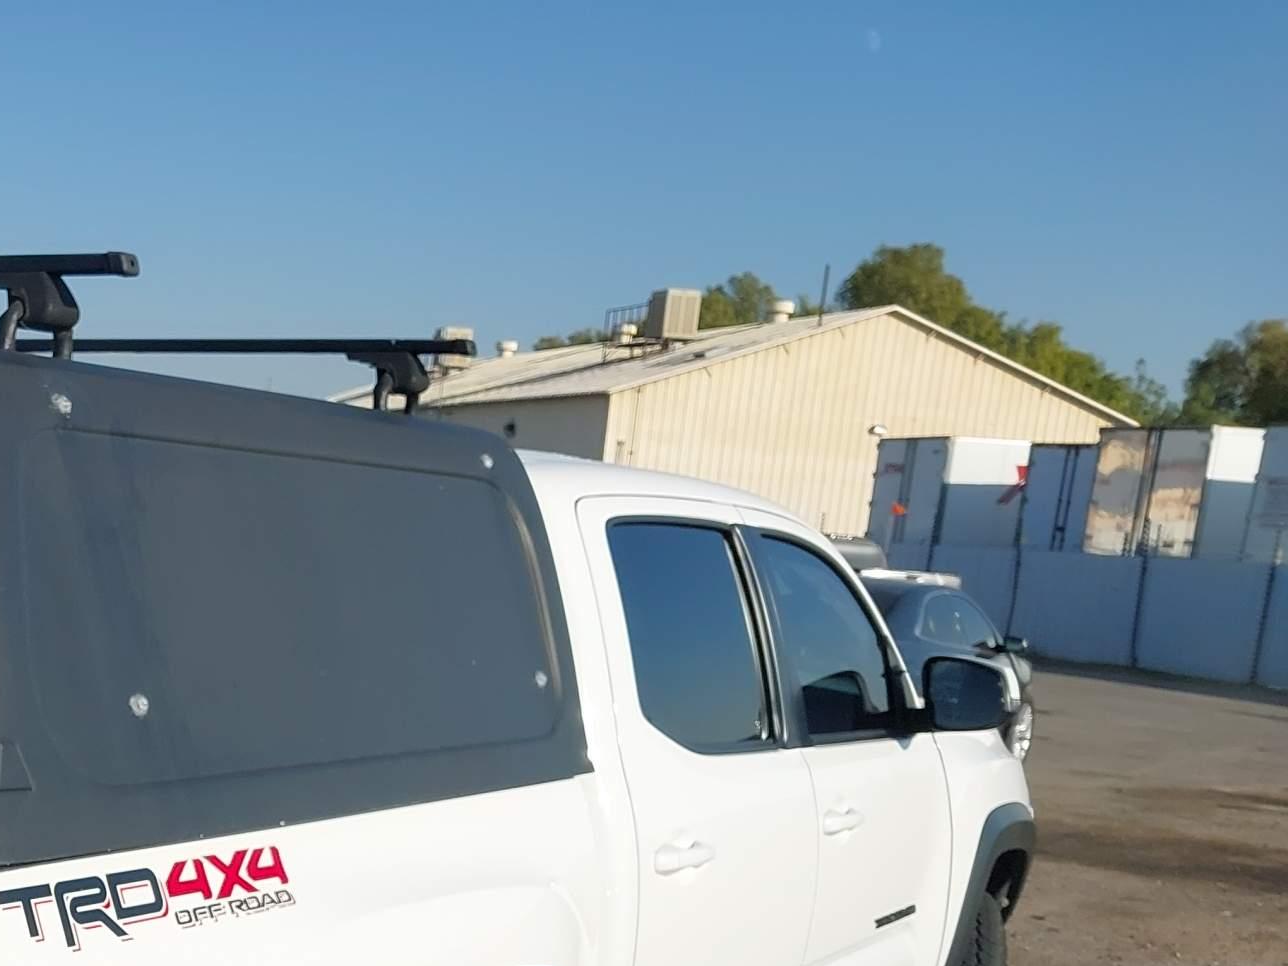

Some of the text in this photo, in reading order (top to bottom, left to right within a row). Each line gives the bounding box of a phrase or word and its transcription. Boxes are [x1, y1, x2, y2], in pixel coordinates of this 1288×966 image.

[166, 846, 289, 900] 4X4
[175, 889, 295, 928] OFF ROAD
